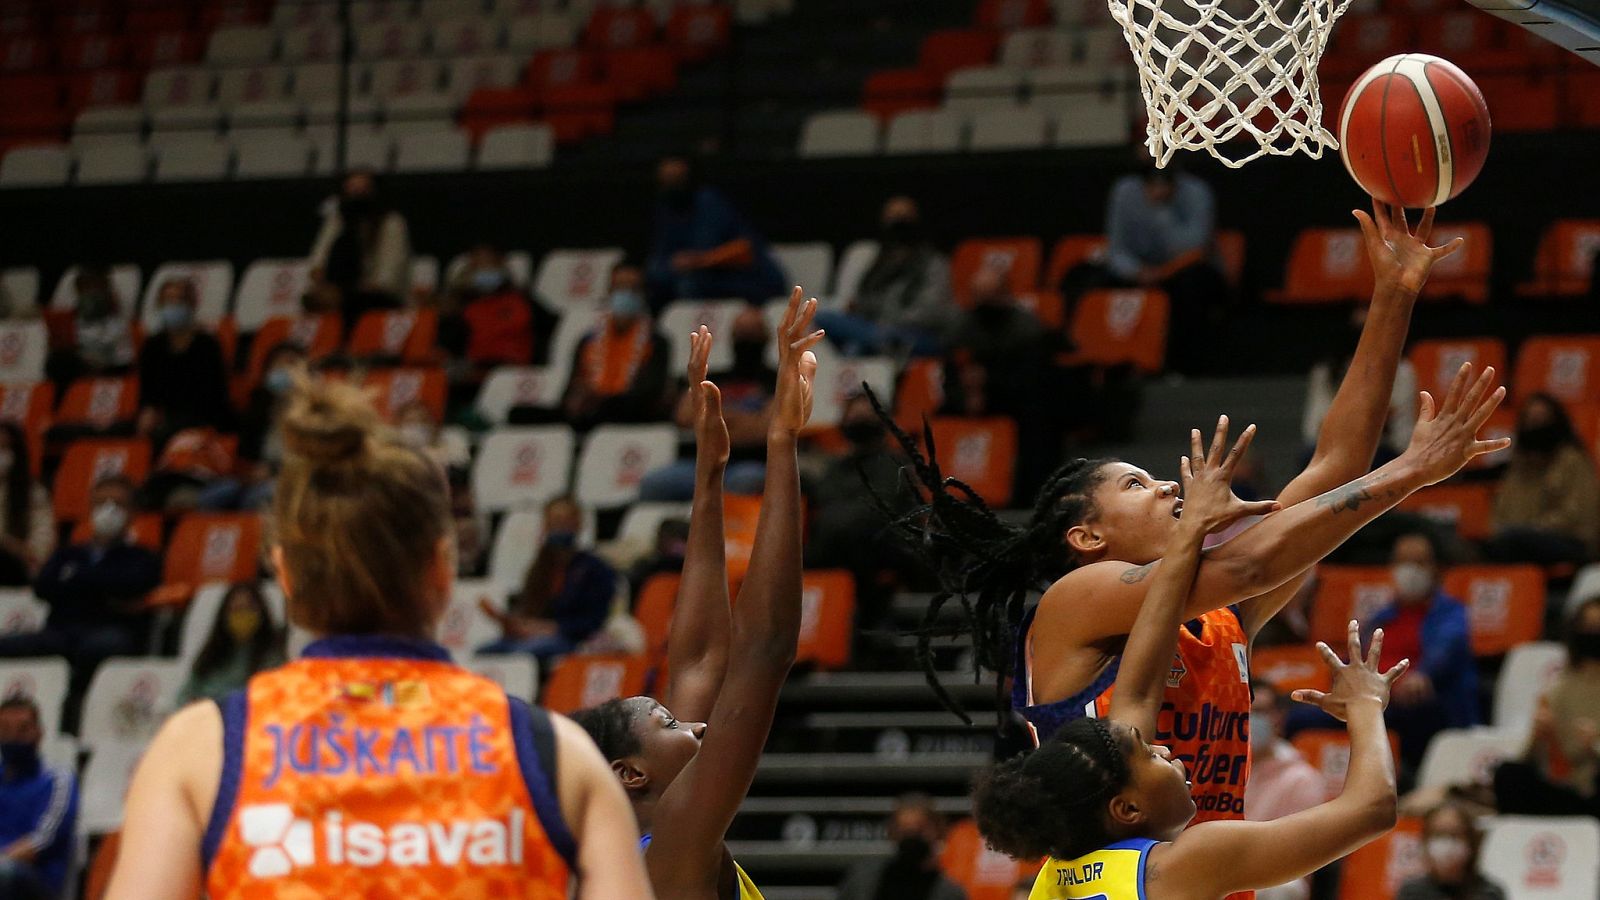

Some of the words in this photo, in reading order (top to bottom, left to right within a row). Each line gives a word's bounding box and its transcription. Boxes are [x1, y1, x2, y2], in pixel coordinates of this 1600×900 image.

[263, 714, 497, 788] JUŠKAITĖ
[325, 808, 524, 866] isaval
[1056, 862, 1104, 886] TAYLOR
